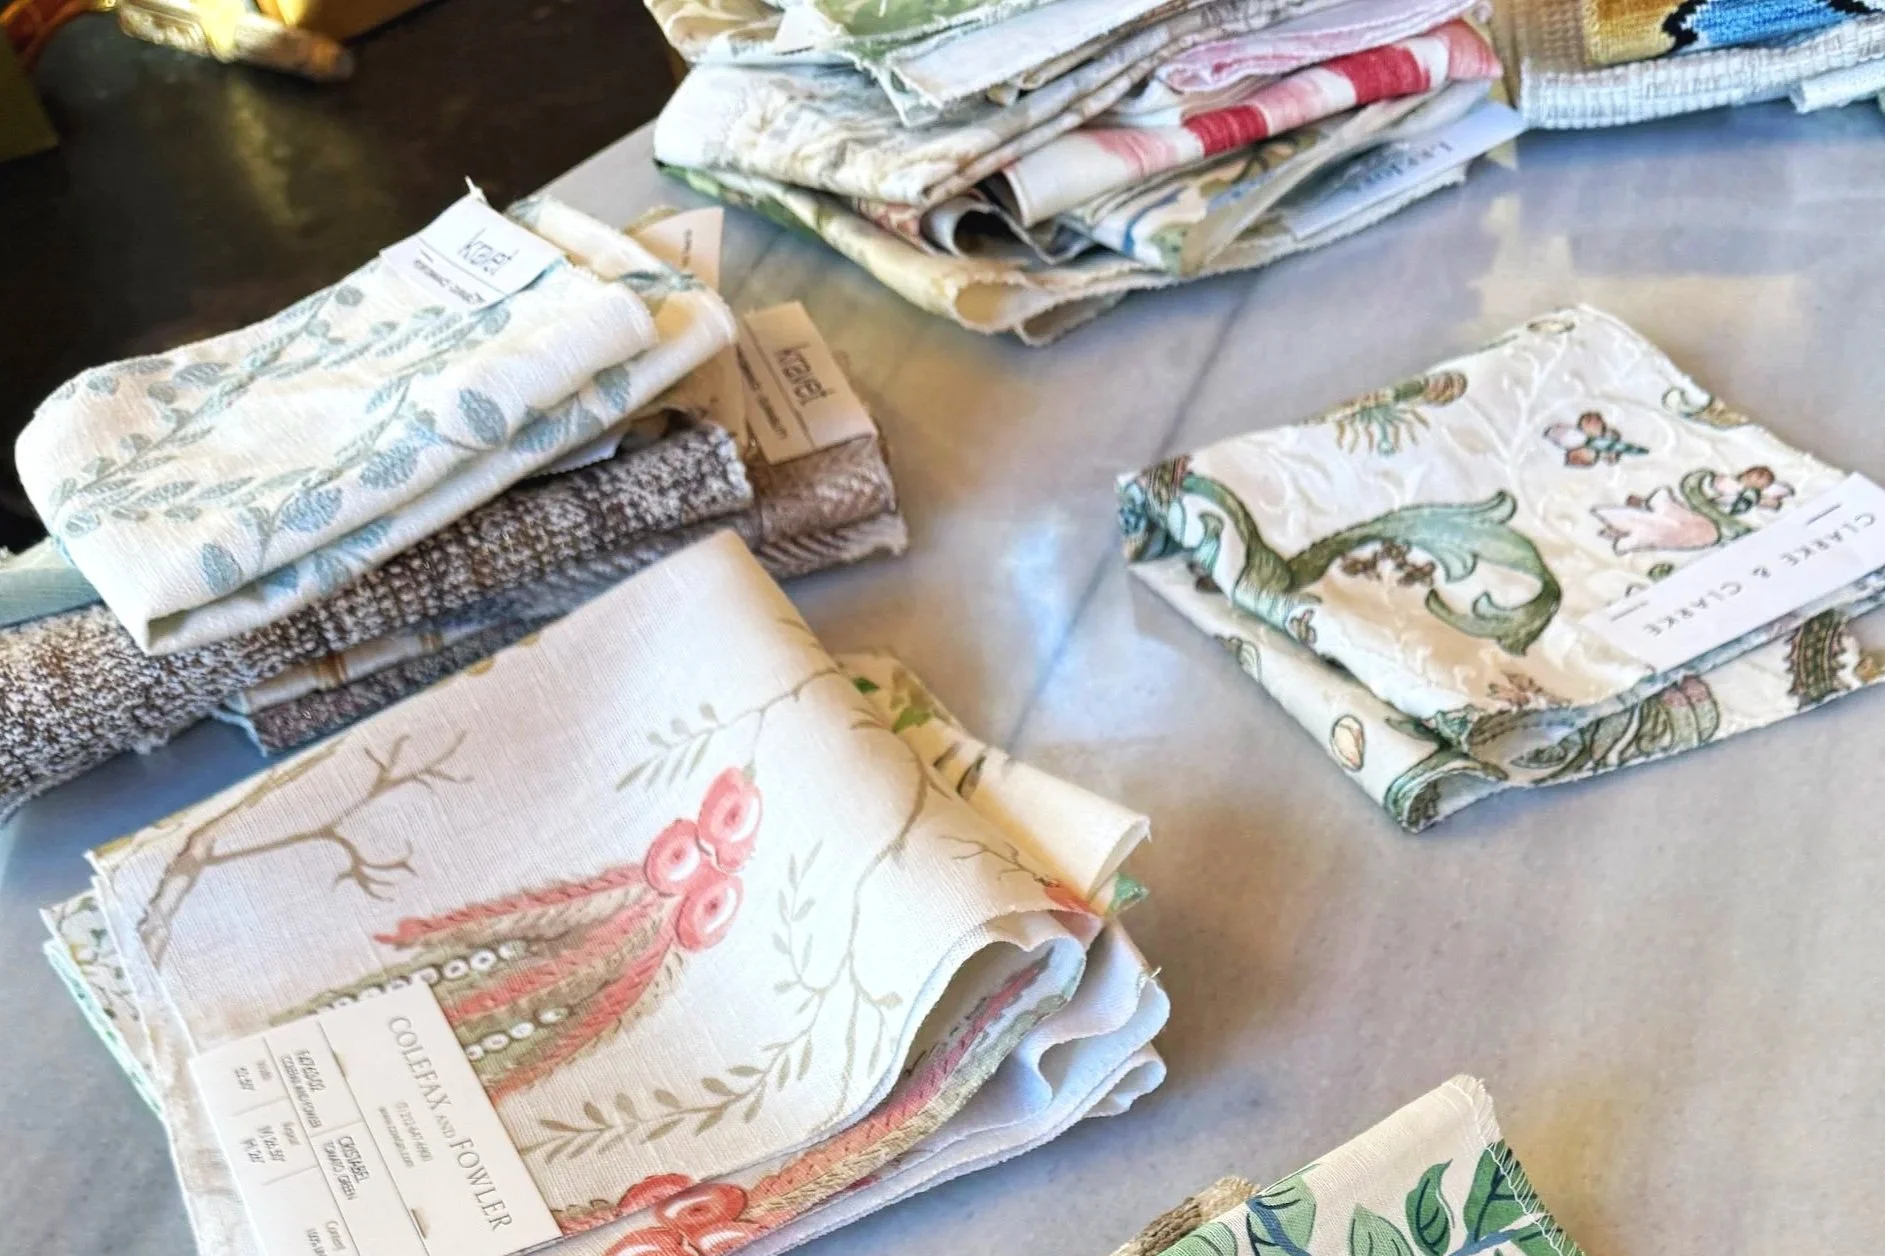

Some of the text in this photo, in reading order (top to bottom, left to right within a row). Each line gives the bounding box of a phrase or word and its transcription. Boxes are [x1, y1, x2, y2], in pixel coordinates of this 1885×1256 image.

[776, 342, 833, 407] kravet
[1642, 512, 1876, 637] CLARKE & CLARKE
[387, 1015, 513, 1230] COLEFAX AND FOWLER
